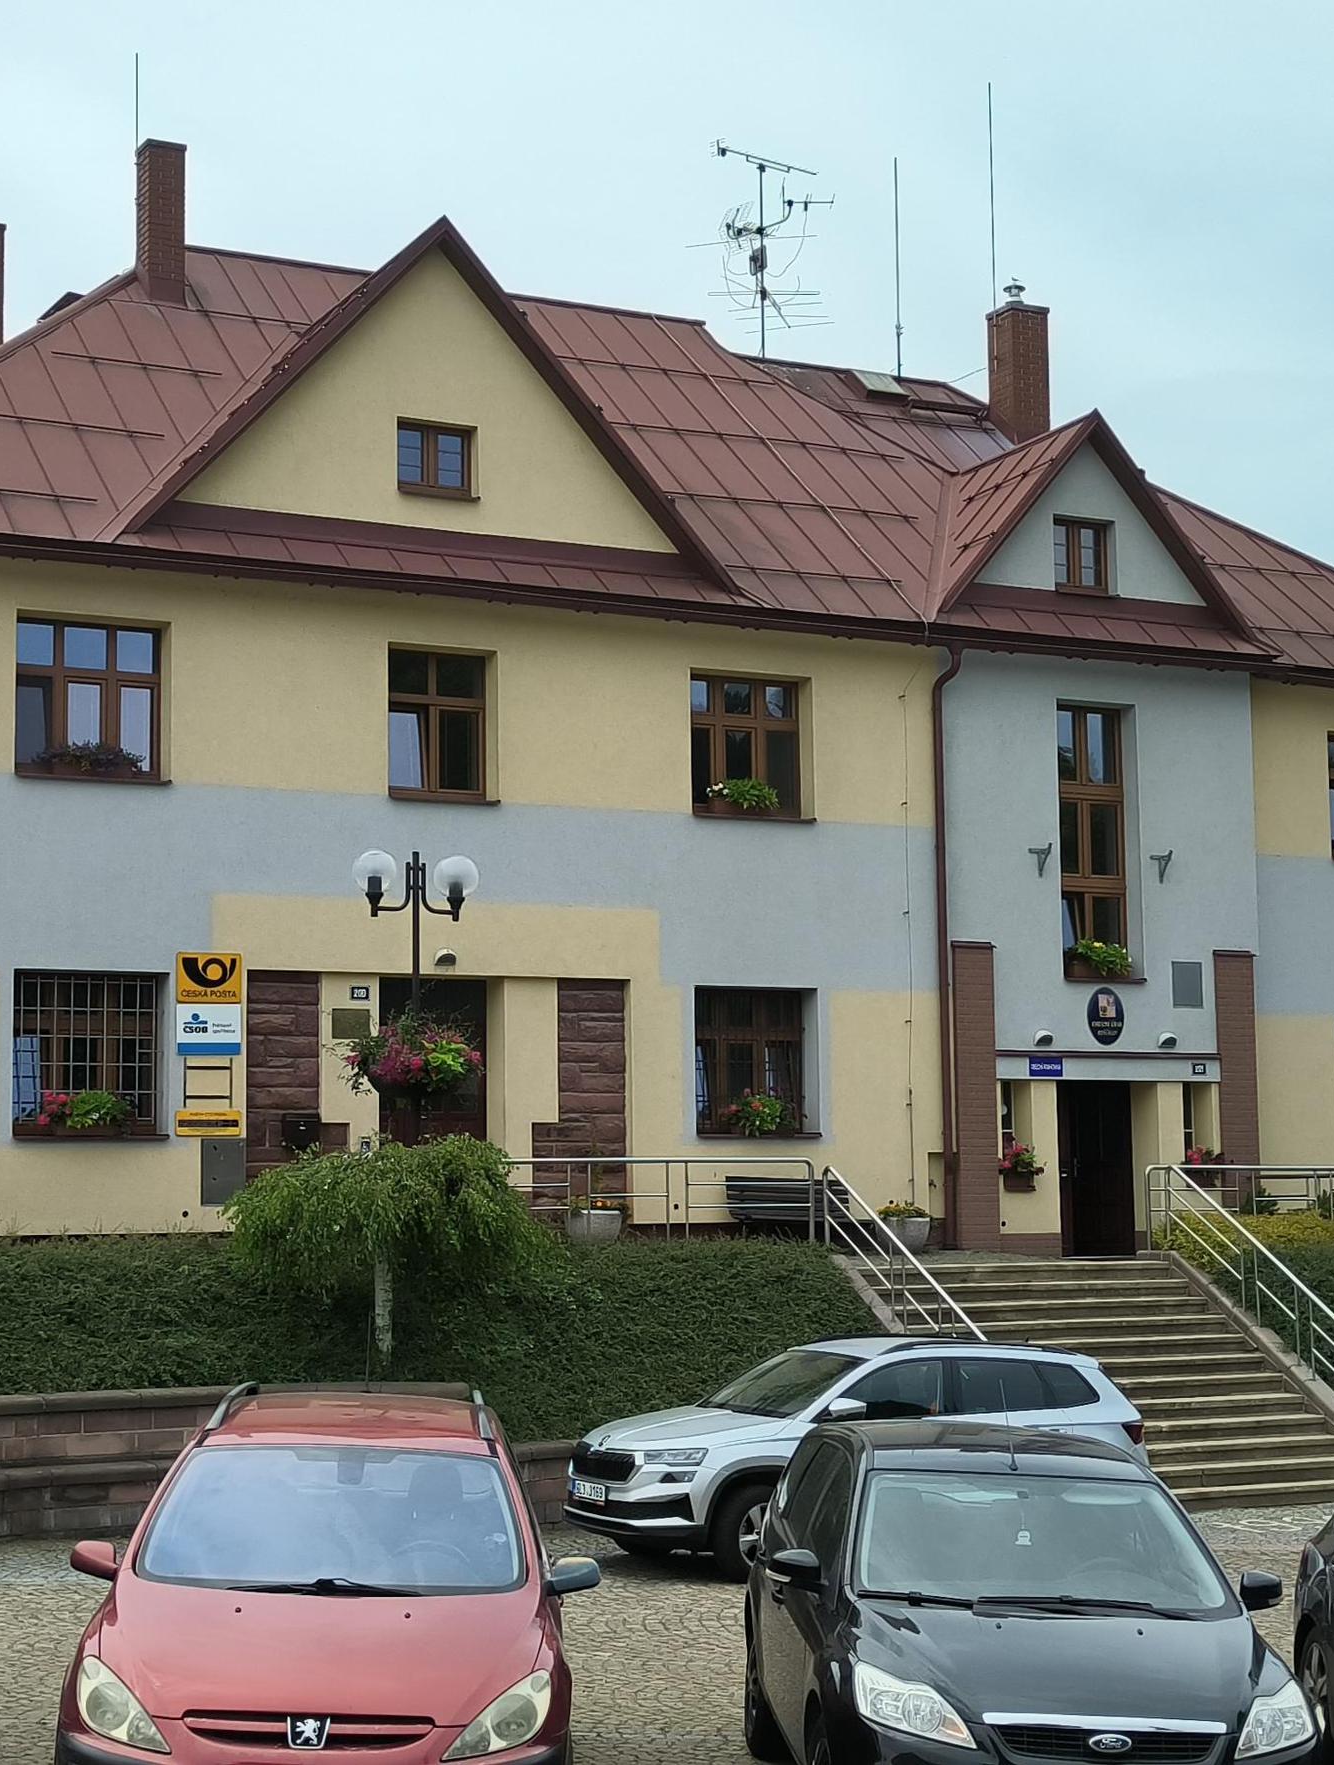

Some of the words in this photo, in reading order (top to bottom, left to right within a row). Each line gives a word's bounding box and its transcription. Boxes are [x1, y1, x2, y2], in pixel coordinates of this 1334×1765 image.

[181, 988, 208, 998] ČESKÁ
[210, 989, 237, 999] POŠTA
[183, 1025, 208, 1034] ČSOB
